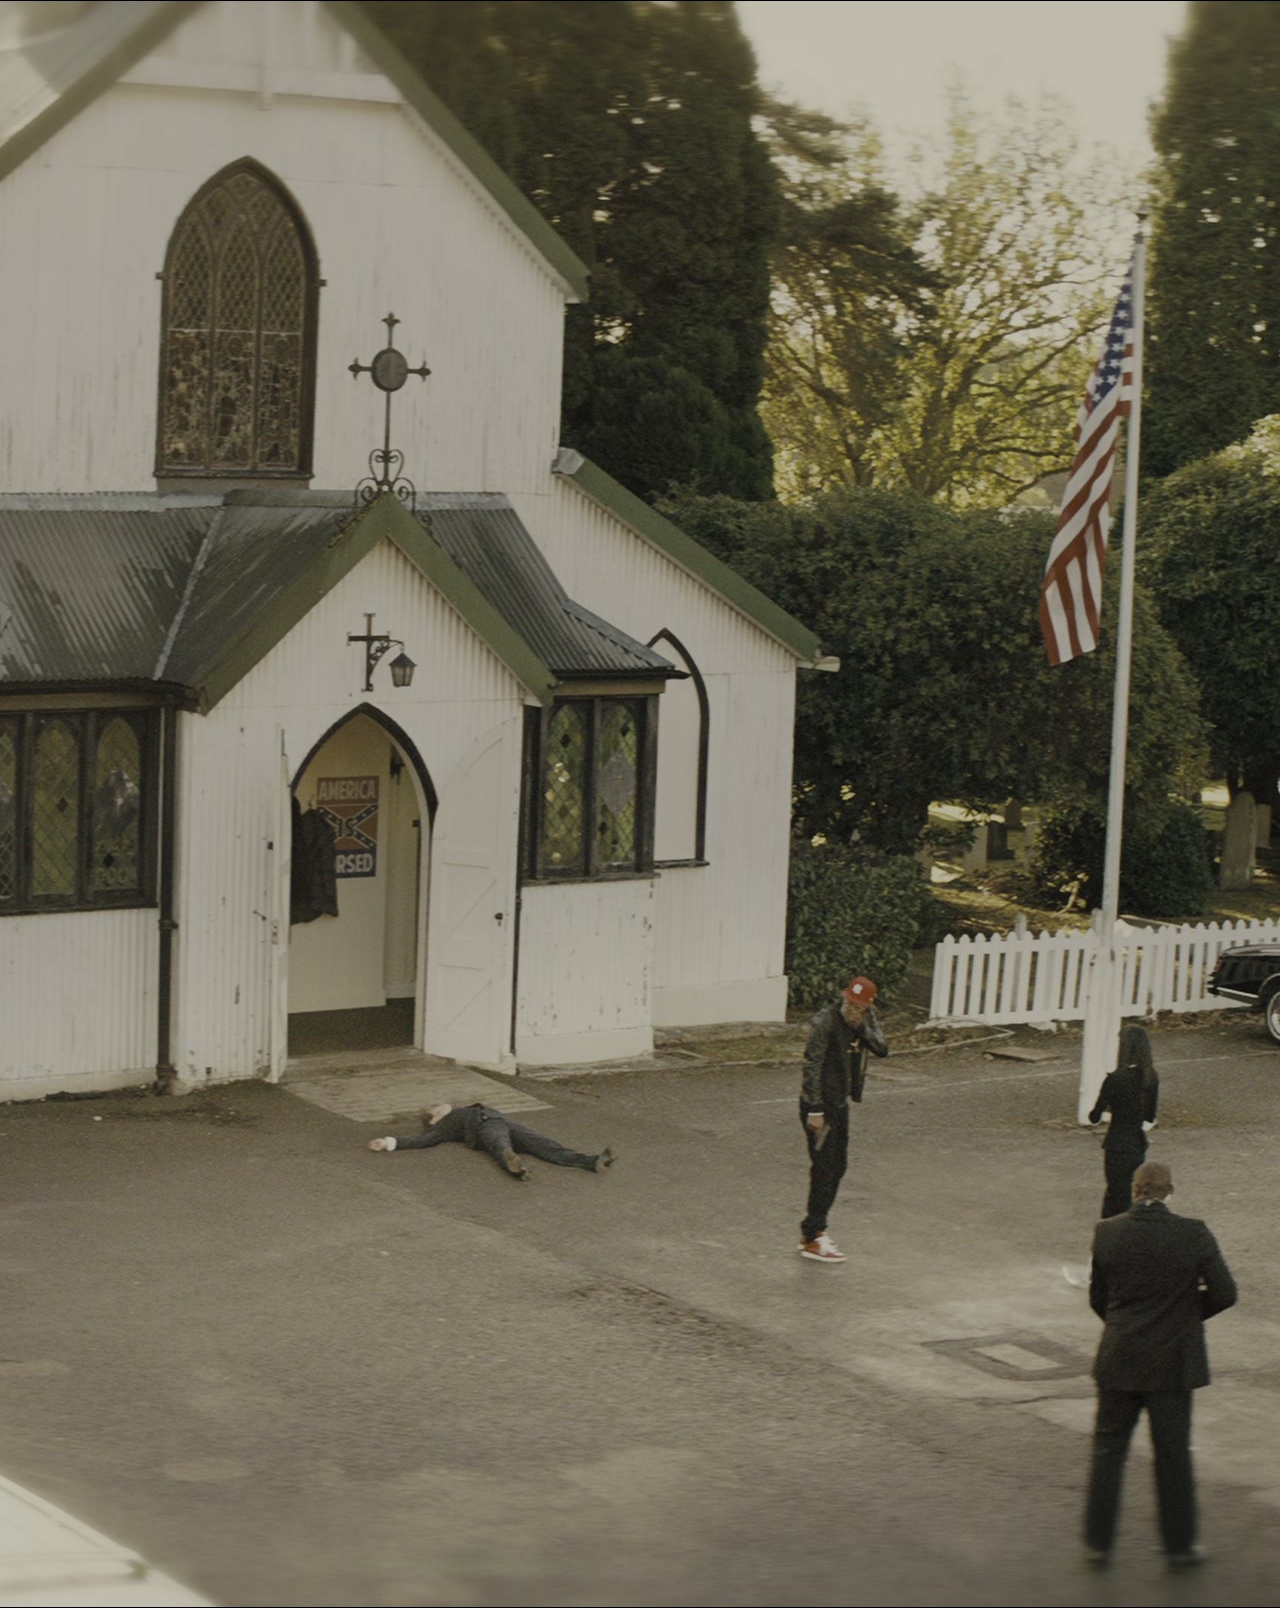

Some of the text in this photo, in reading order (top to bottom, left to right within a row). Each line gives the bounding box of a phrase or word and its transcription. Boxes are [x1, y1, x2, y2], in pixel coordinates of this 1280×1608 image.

[319, 780, 376, 800] AMERICA
[338, 817, 355, 836] IS
[335, 853, 373, 873] RSED
